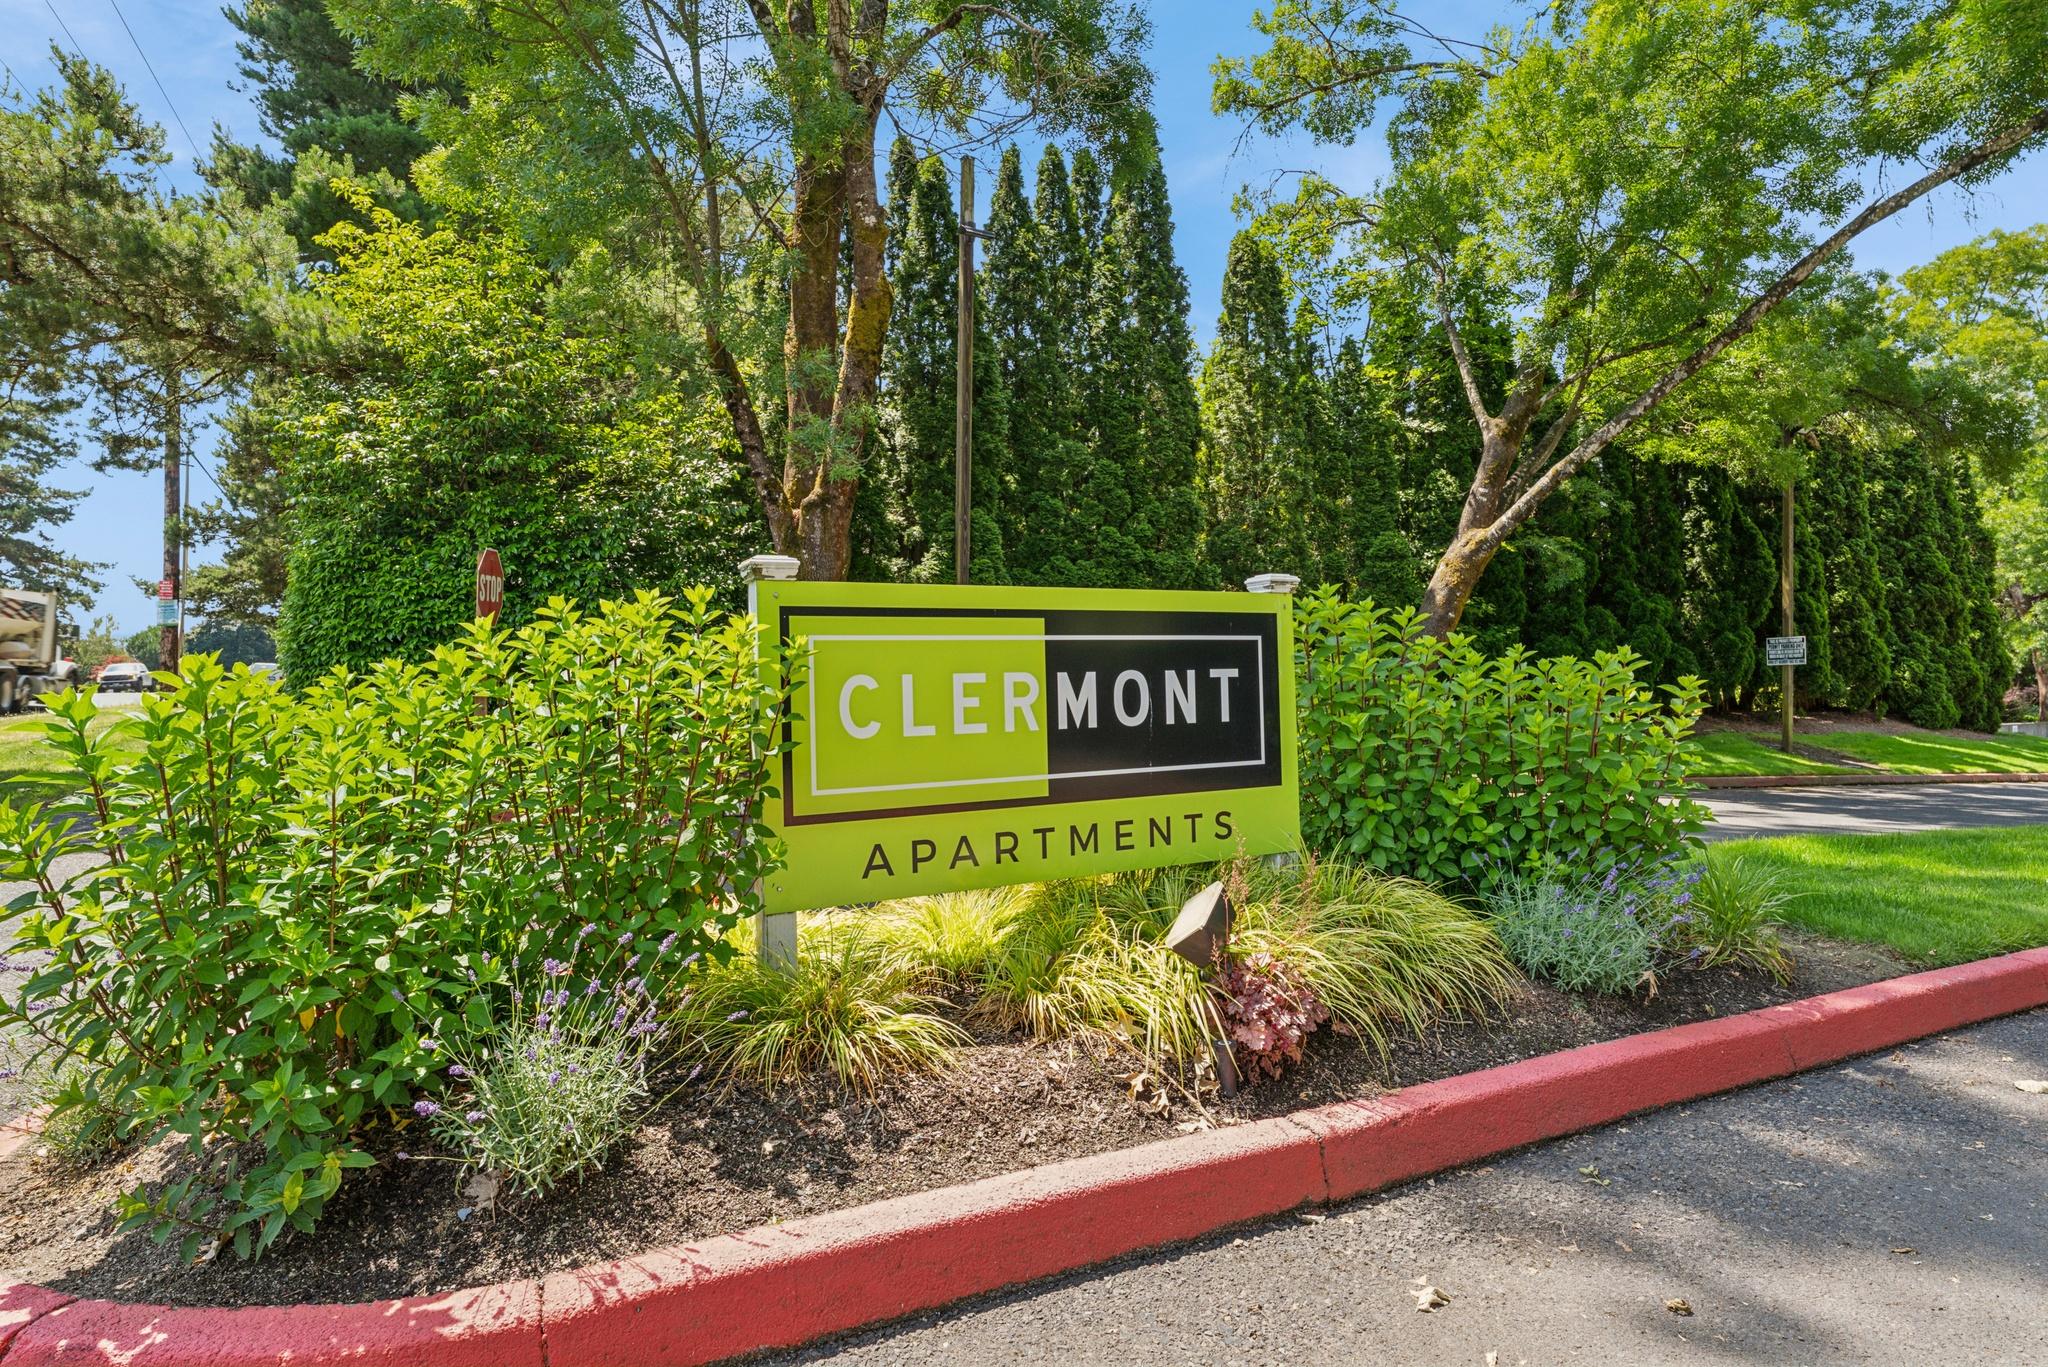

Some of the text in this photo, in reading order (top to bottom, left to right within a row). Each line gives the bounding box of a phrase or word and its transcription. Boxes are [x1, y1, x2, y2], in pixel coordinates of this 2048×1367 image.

[480, 574, 502, 602] STOP
[838, 668, 1240, 739] CLERMONT
[861, 810, 1234, 880] APARTMENTS
